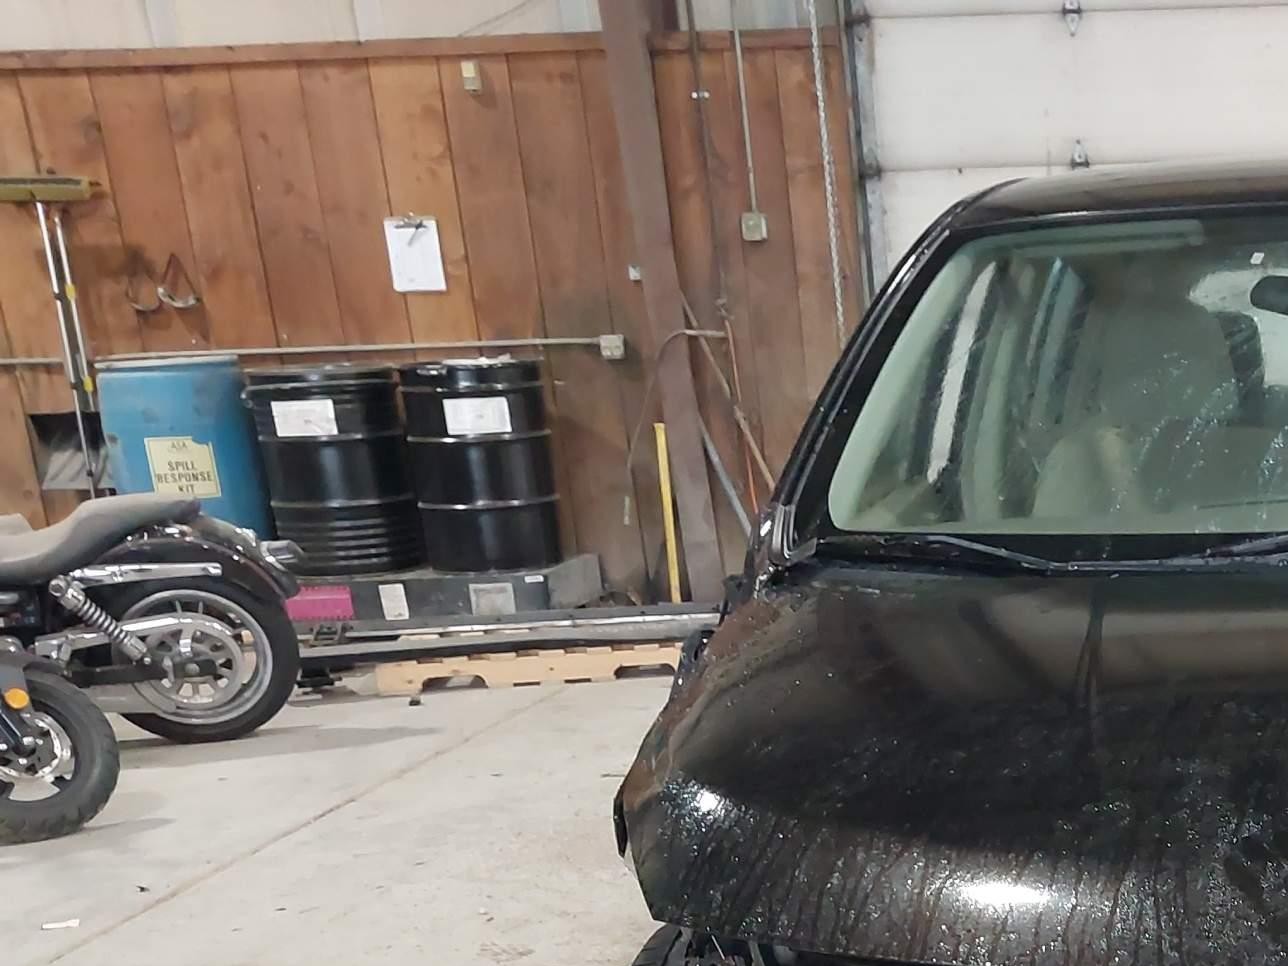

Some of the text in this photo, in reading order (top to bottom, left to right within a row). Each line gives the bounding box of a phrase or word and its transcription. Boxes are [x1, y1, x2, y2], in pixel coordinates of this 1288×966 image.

[167, 460, 197, 472] SPILL
[156, 471, 214, 484] RESPONSE
[177, 484, 195, 494] KIT
